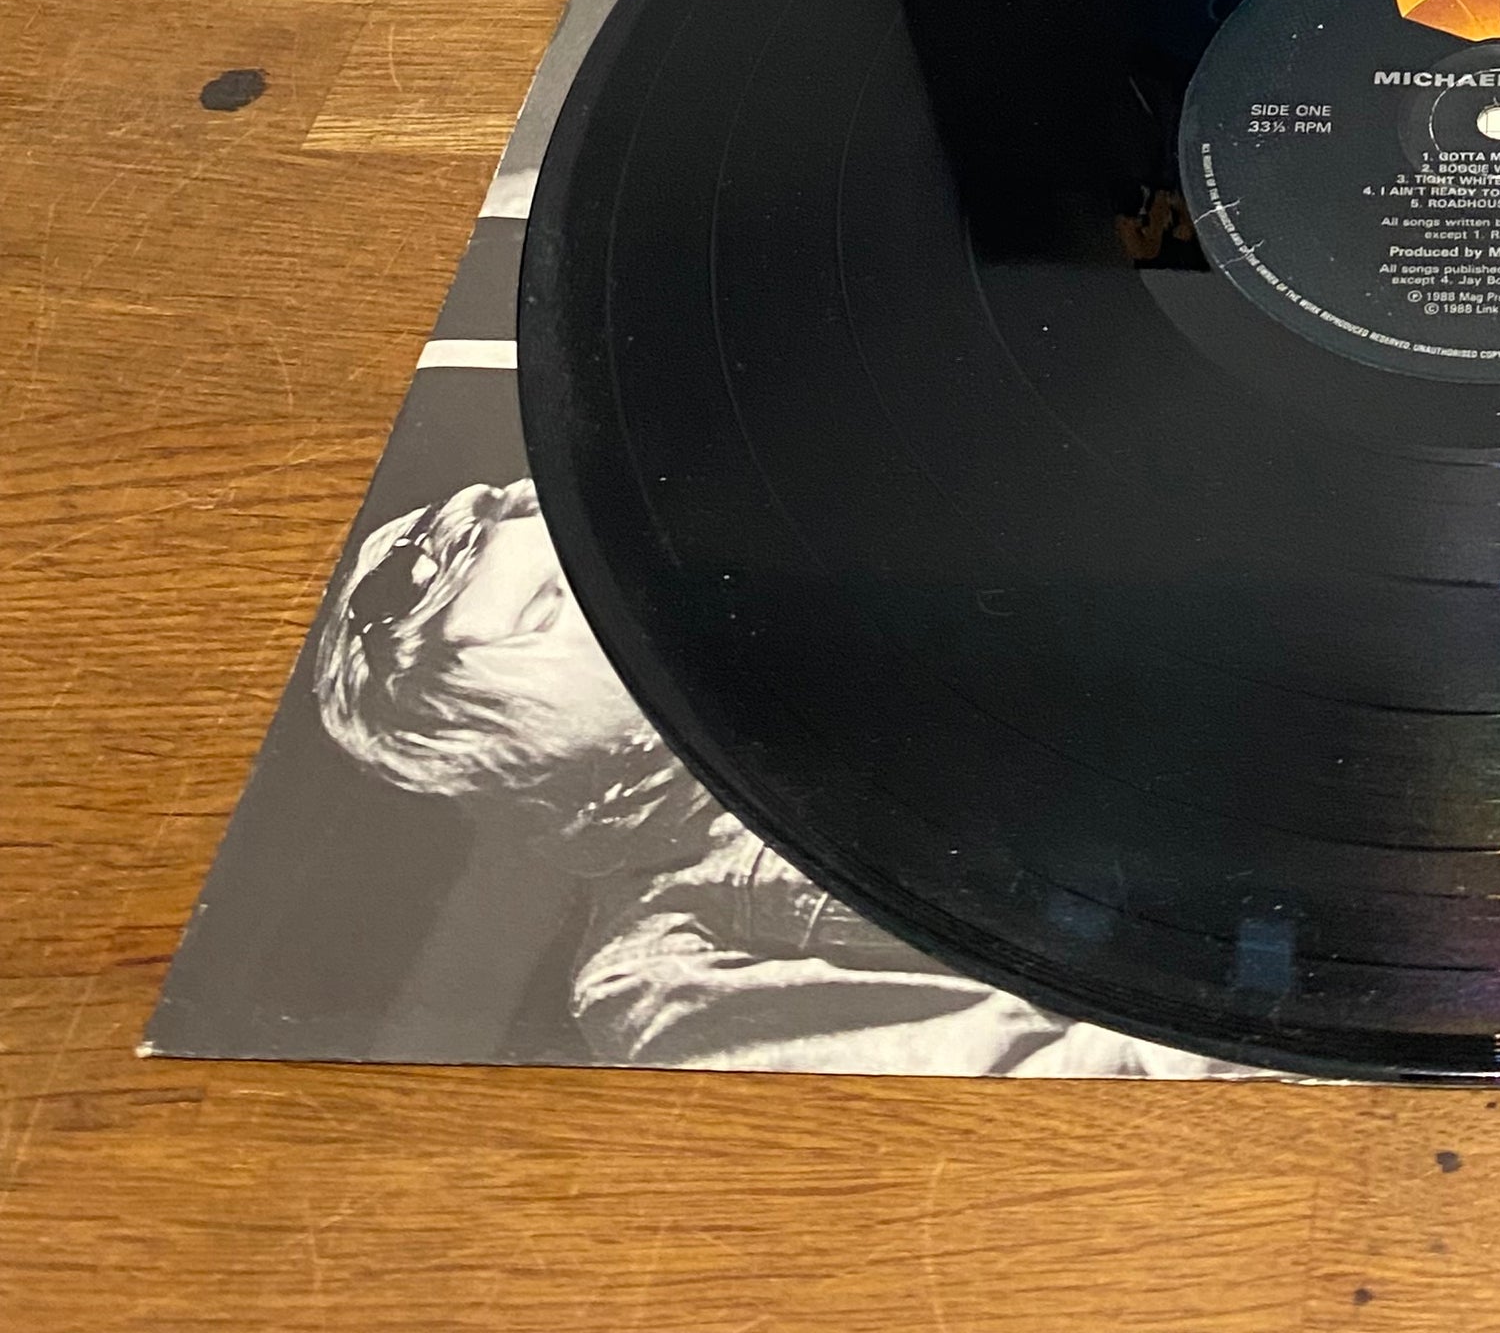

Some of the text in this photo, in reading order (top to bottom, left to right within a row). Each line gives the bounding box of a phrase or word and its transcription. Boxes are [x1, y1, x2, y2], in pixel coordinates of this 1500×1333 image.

[1250, 104, 1332, 117] SIDE ONE
[1294, 121, 1332, 133] RPM
[1439, 152, 1486, 162] GOTTA
[1414, 175, 1455, 184] TIGHT
[1381, 187, 1385, 196] I
[1430, 187, 1476, 197] READY
[1481, 188, 1500, 197] TO
[1381, 217, 1398, 226] All
[1403, 219, 1440, 228] songs
[1445, 218, 1490, 227] written
[1425, 231, 1468, 241] except
[1389, 246, 1459, 258] Produced
[1465, 247, 1482, 259] by
[1379, 264, 1397, 273] All
[1401, 265, 1440, 275] songs
[1392, 276, 1435, 286] except
[1459, 276, 1482, 286] Jay
[1426, 292, 1455, 302] 1988
[1459, 293, 1483, 304] Mag
[1444, 304, 1472, 314] 1988
[1476, 304, 1499, 314] Link
